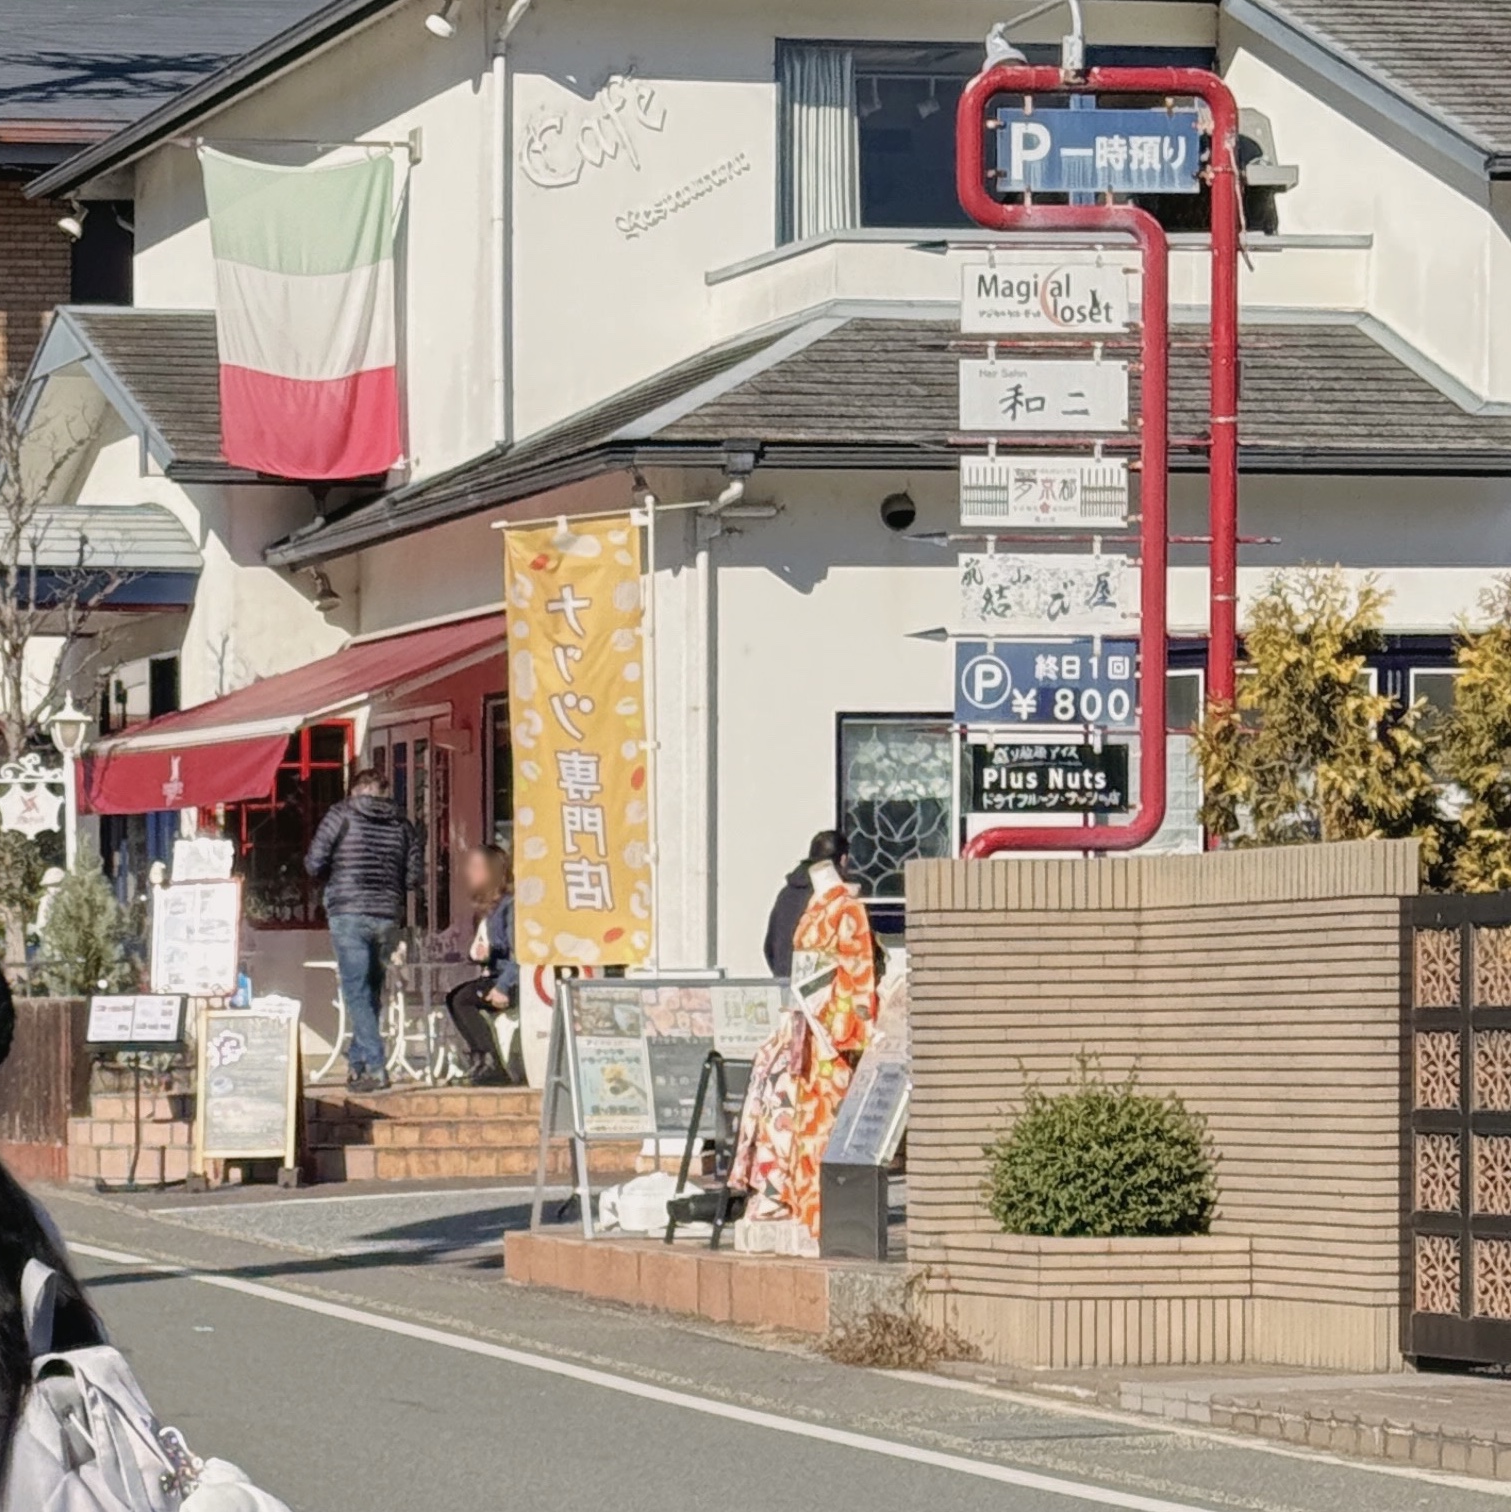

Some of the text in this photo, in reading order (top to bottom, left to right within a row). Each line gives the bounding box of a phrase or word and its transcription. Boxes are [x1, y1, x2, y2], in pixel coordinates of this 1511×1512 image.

[1010, 122, 1187, 180] P 一時預り
[983, 768, 1106, 789] Plus Nuts
